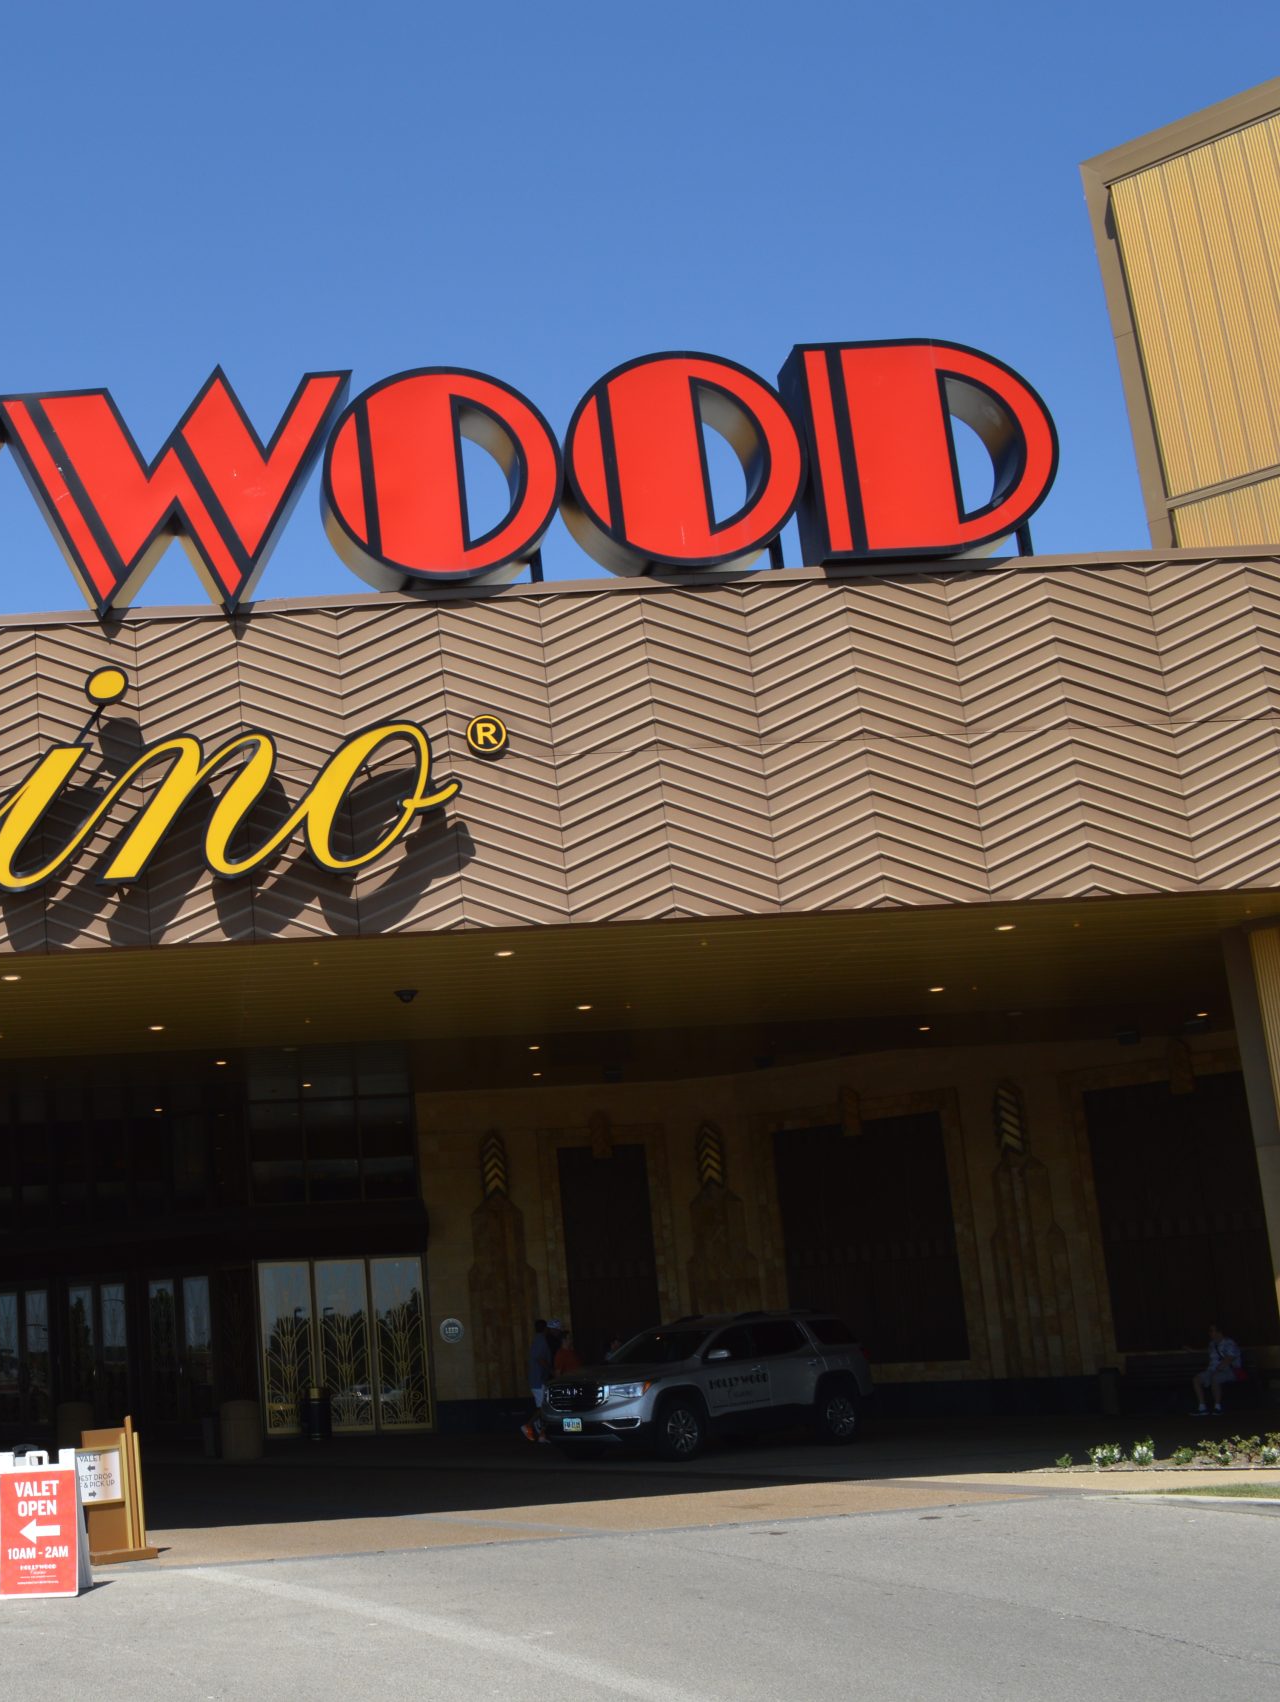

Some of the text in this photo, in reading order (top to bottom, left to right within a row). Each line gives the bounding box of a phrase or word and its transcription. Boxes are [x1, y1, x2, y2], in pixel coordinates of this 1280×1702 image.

[79, 1453, 101, 1463] VALET
[79, 1472, 113, 1482] EST DROP
[14, 1480, 60, 1498] VALET
[89, 1480, 105, 1488] PICK
[106, 1479, 116, 1487] UP
[17, 1500, 57, 1517] OPEN
[7, 1547, 36, 1560] 10AM
[45, 1546, 69, 1559] 2AM
